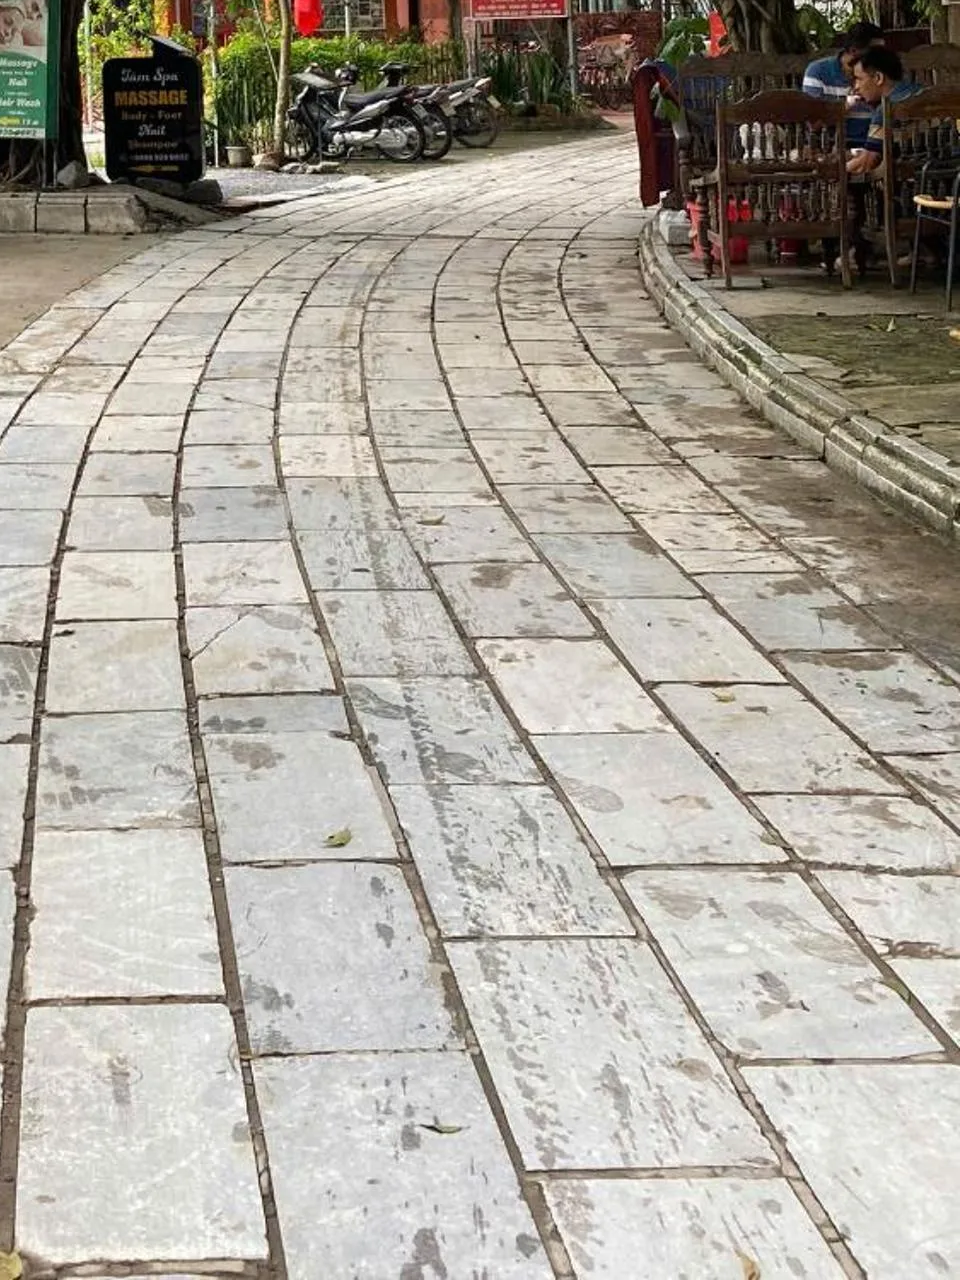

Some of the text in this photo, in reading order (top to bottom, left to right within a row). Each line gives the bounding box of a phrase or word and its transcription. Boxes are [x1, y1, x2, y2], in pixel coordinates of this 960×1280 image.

[0, 57, 38, 69] Massage
[152, 66, 179, 86] Spa
[114, 90, 187, 106] MASSAGE
